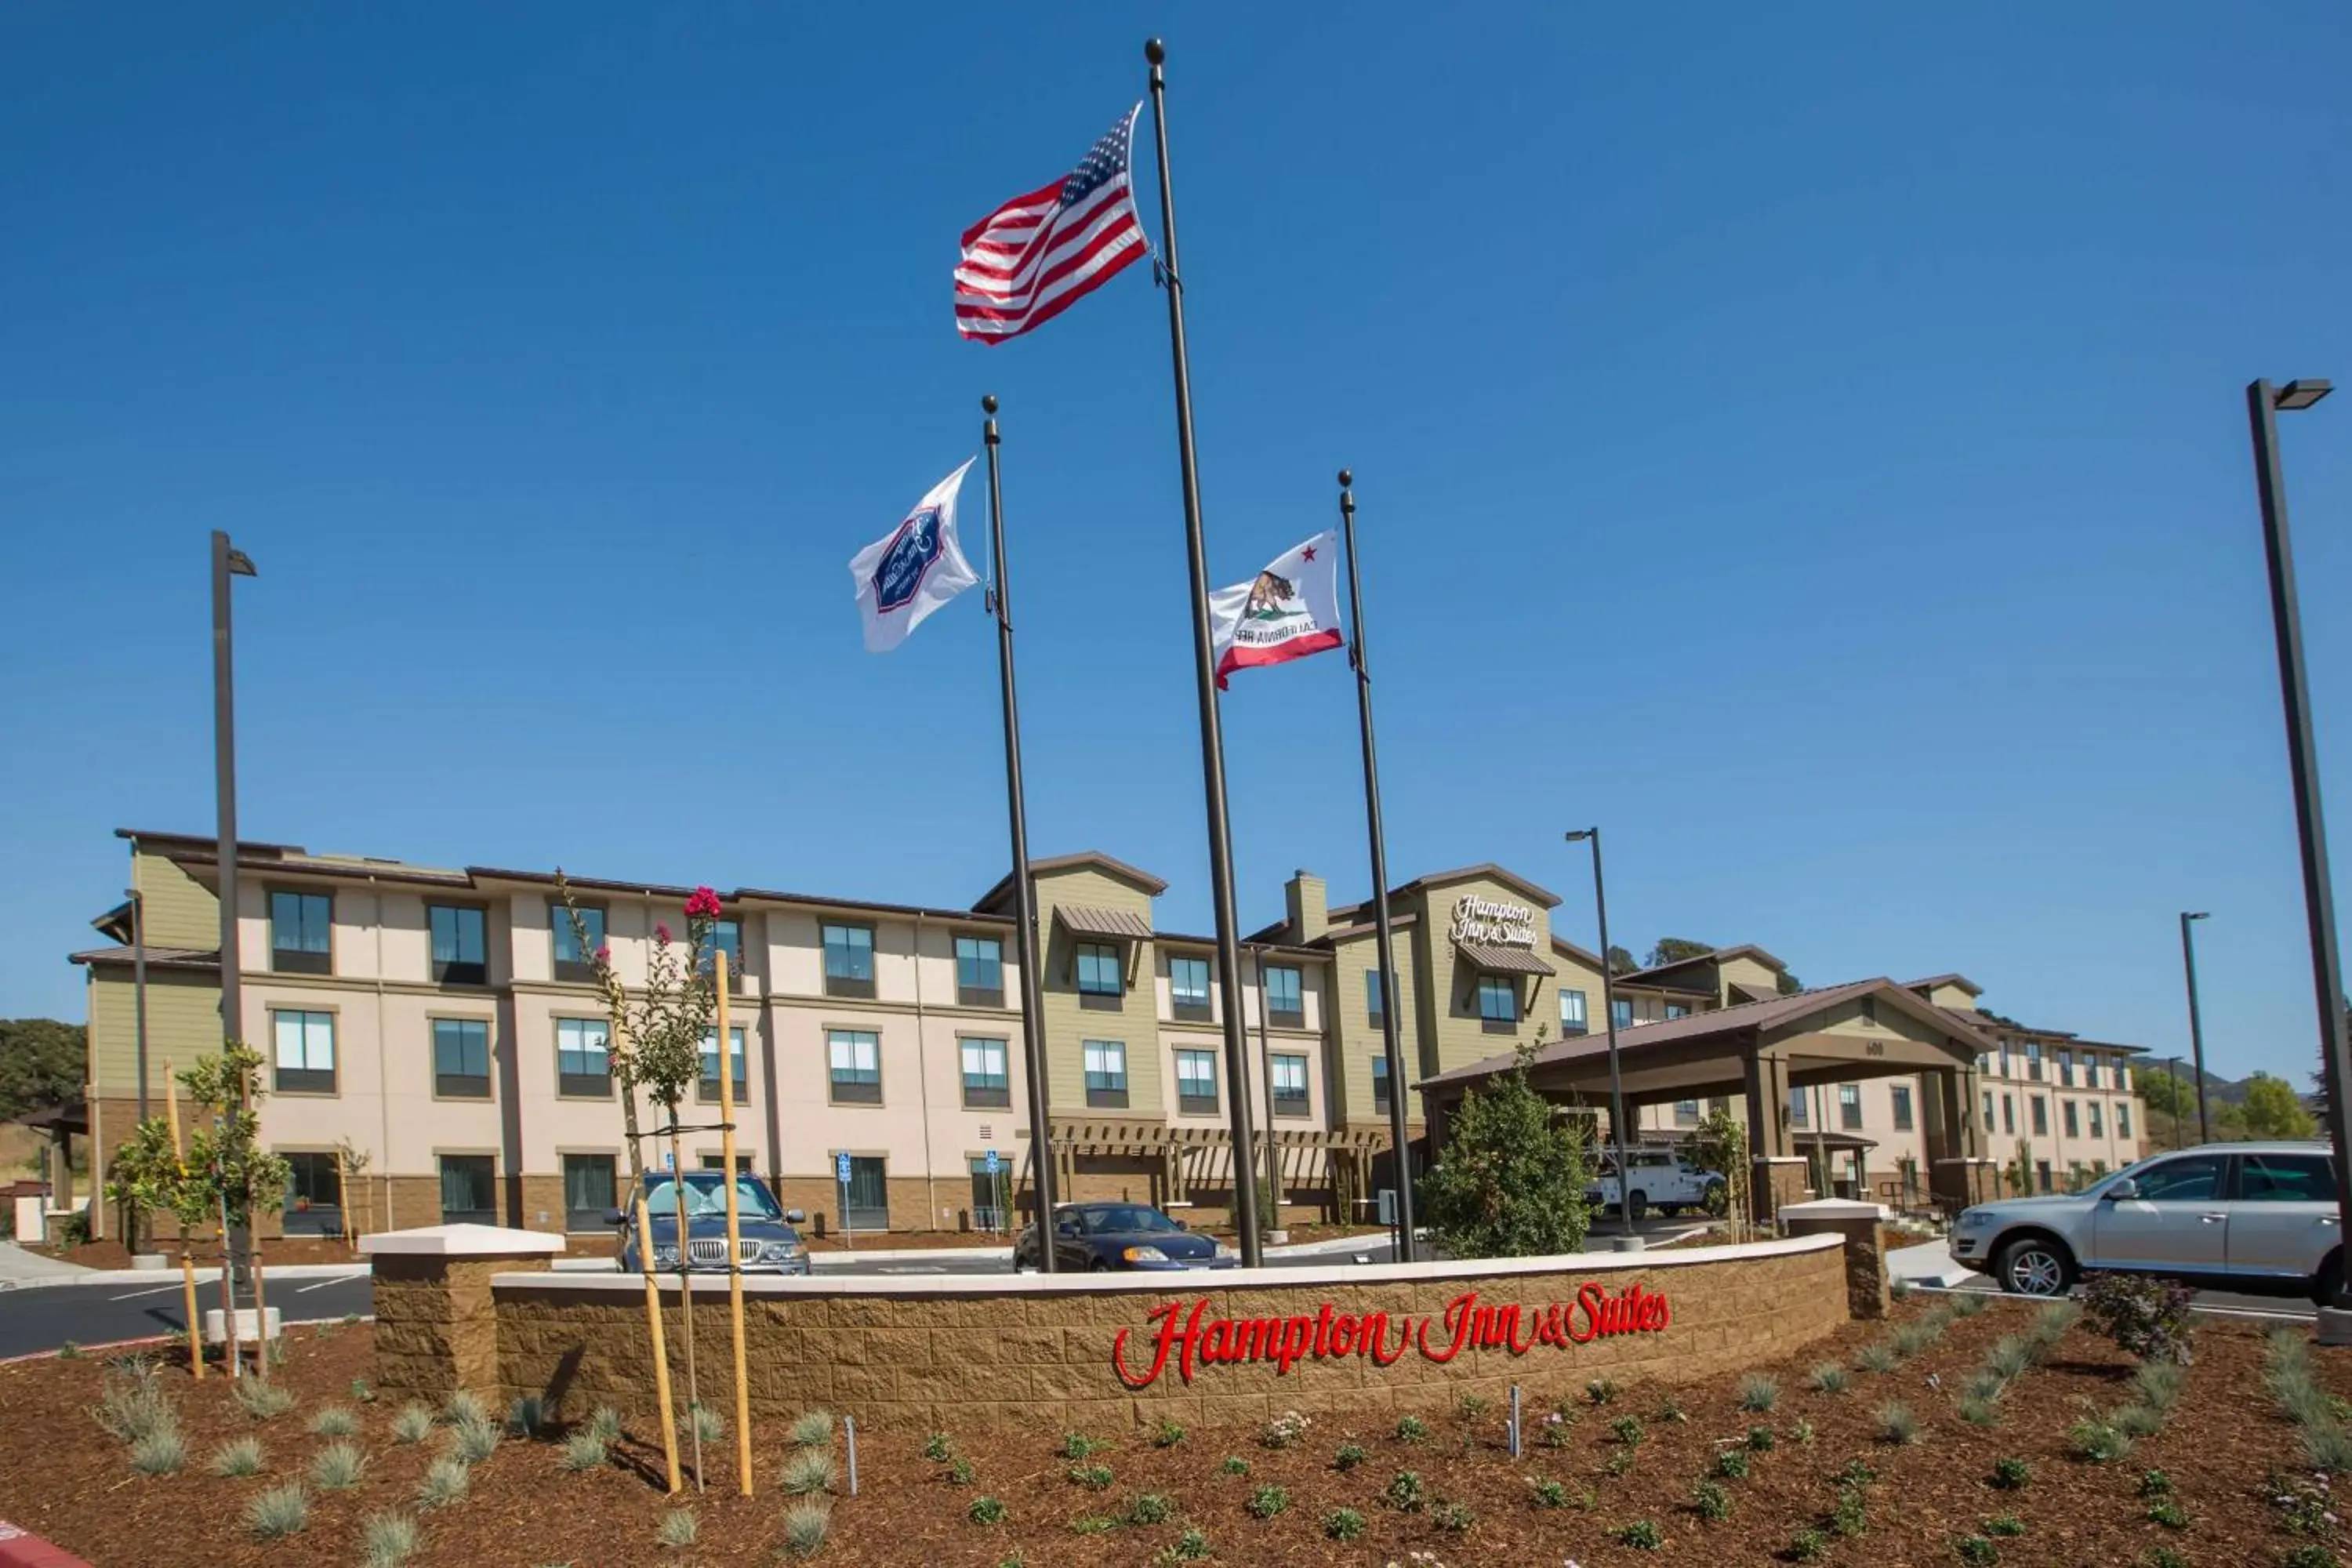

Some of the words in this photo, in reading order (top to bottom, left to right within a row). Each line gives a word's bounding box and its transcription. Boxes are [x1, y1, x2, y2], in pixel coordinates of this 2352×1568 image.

[1456, 894, 1534, 924] Hampton
[1452, 918, 1490, 941] Inn
[1497, 921, 1537, 945] Suites
[1115, 1297, 1412, 1385] Hampton
[1418, 1291, 1541, 1363] Inn
[1539, 1301, 1570, 1349] &
[1564, 1282, 1670, 1343] Suites
